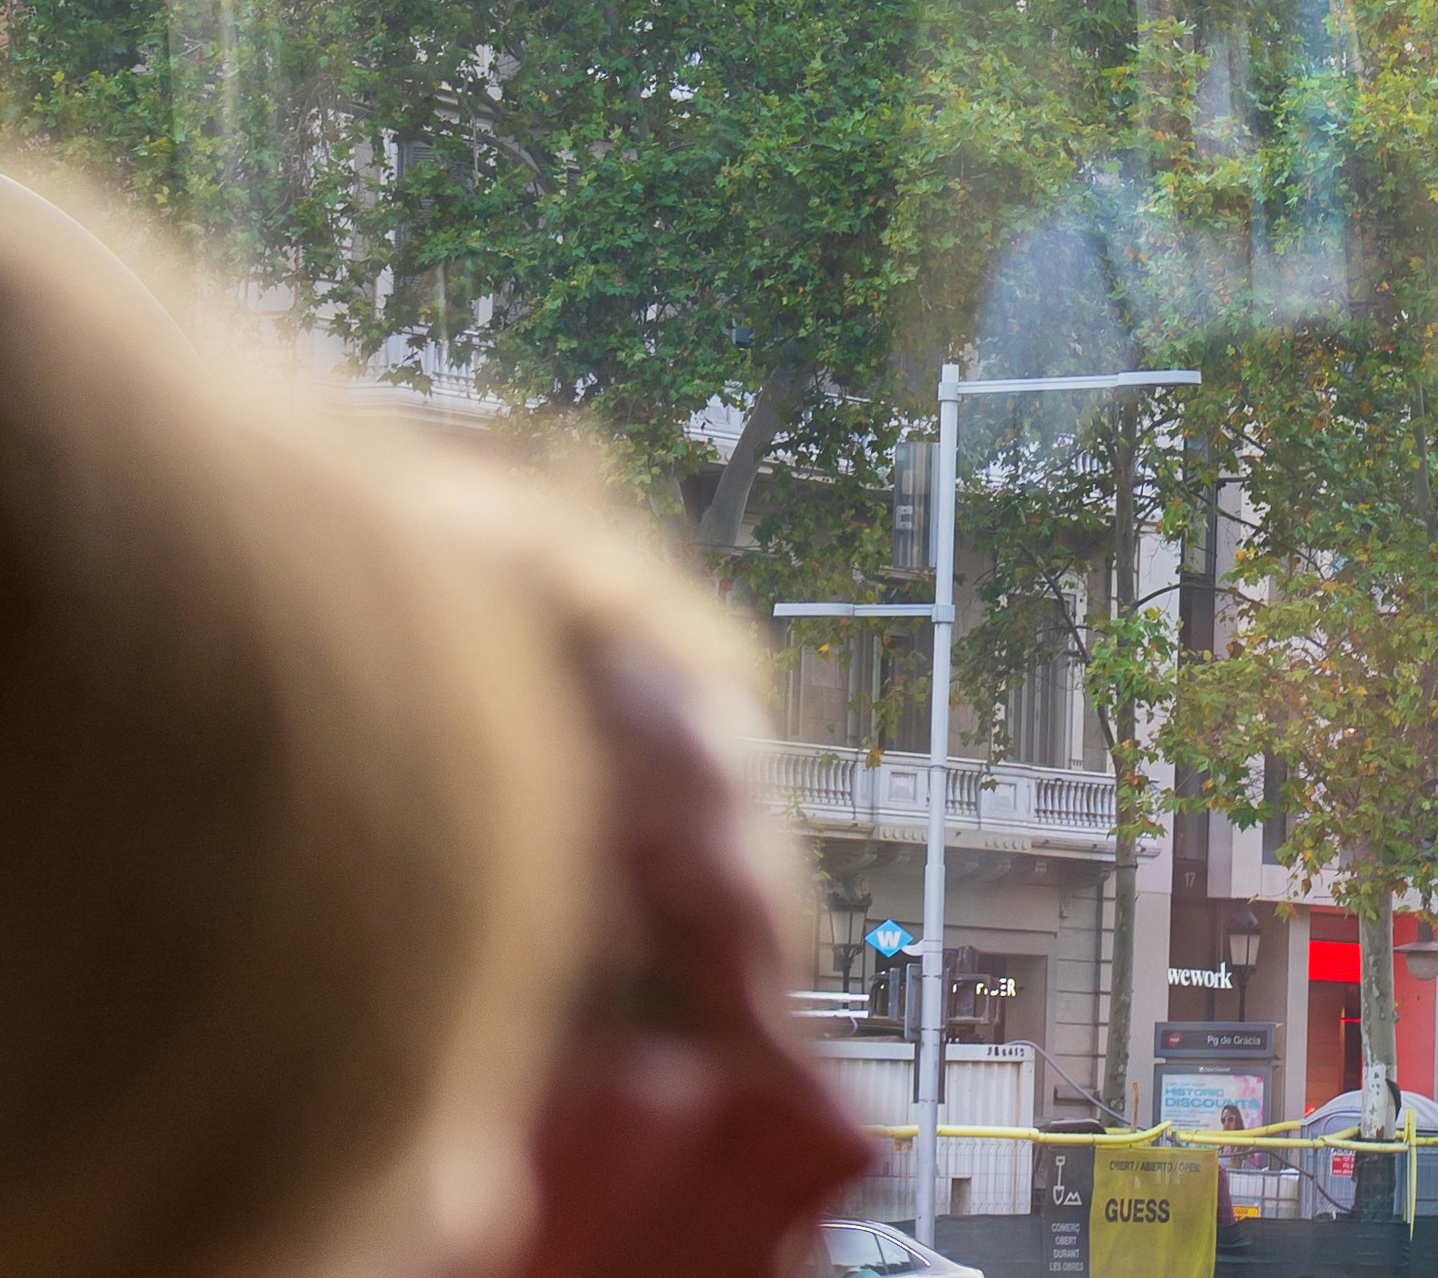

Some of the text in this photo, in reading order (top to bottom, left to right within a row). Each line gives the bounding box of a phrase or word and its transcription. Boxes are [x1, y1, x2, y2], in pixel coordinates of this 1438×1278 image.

[876, 930, 902, 950] W
[1167, 962, 1233, 989] wework
[1104, 1198, 1171, 1223] GUESS
